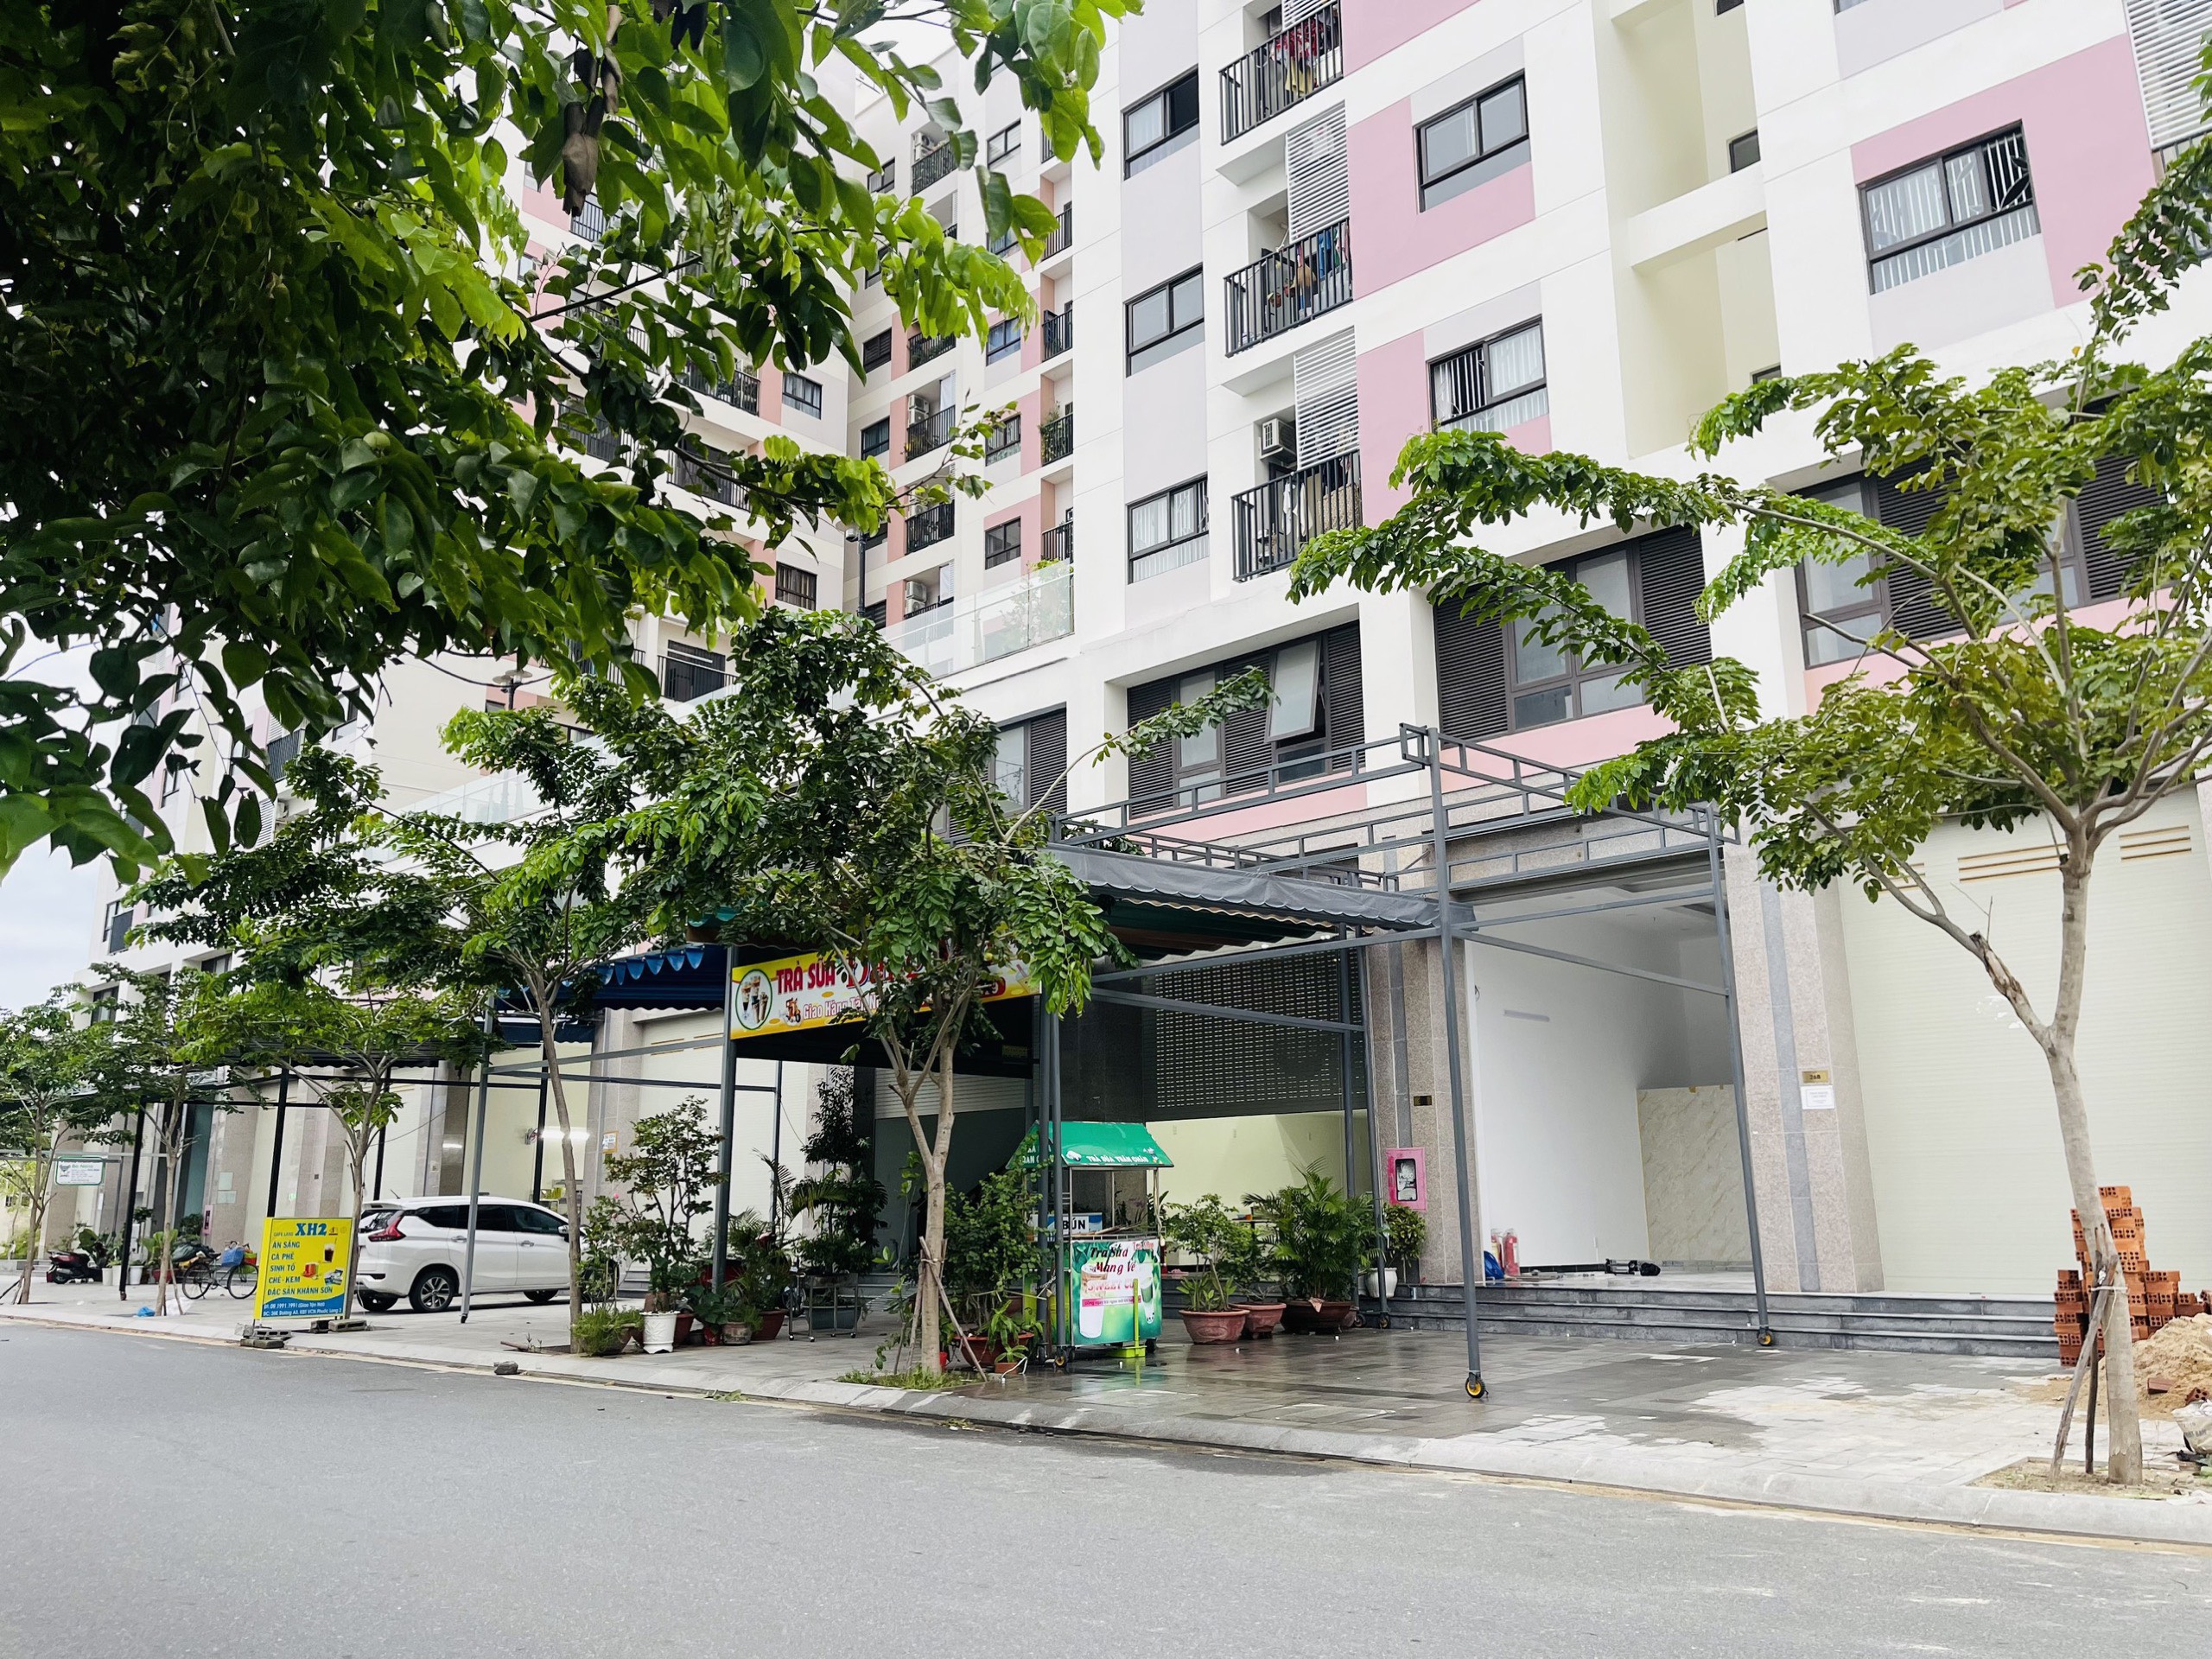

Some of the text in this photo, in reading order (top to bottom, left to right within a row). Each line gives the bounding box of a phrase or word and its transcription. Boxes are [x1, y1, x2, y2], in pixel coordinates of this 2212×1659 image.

[776, 960, 804, 995] TRÀ
[803, 1001, 823, 1020] Giao
[825, 998, 848, 1017] Hàng
[295, 1223, 327, 1236] XH2
